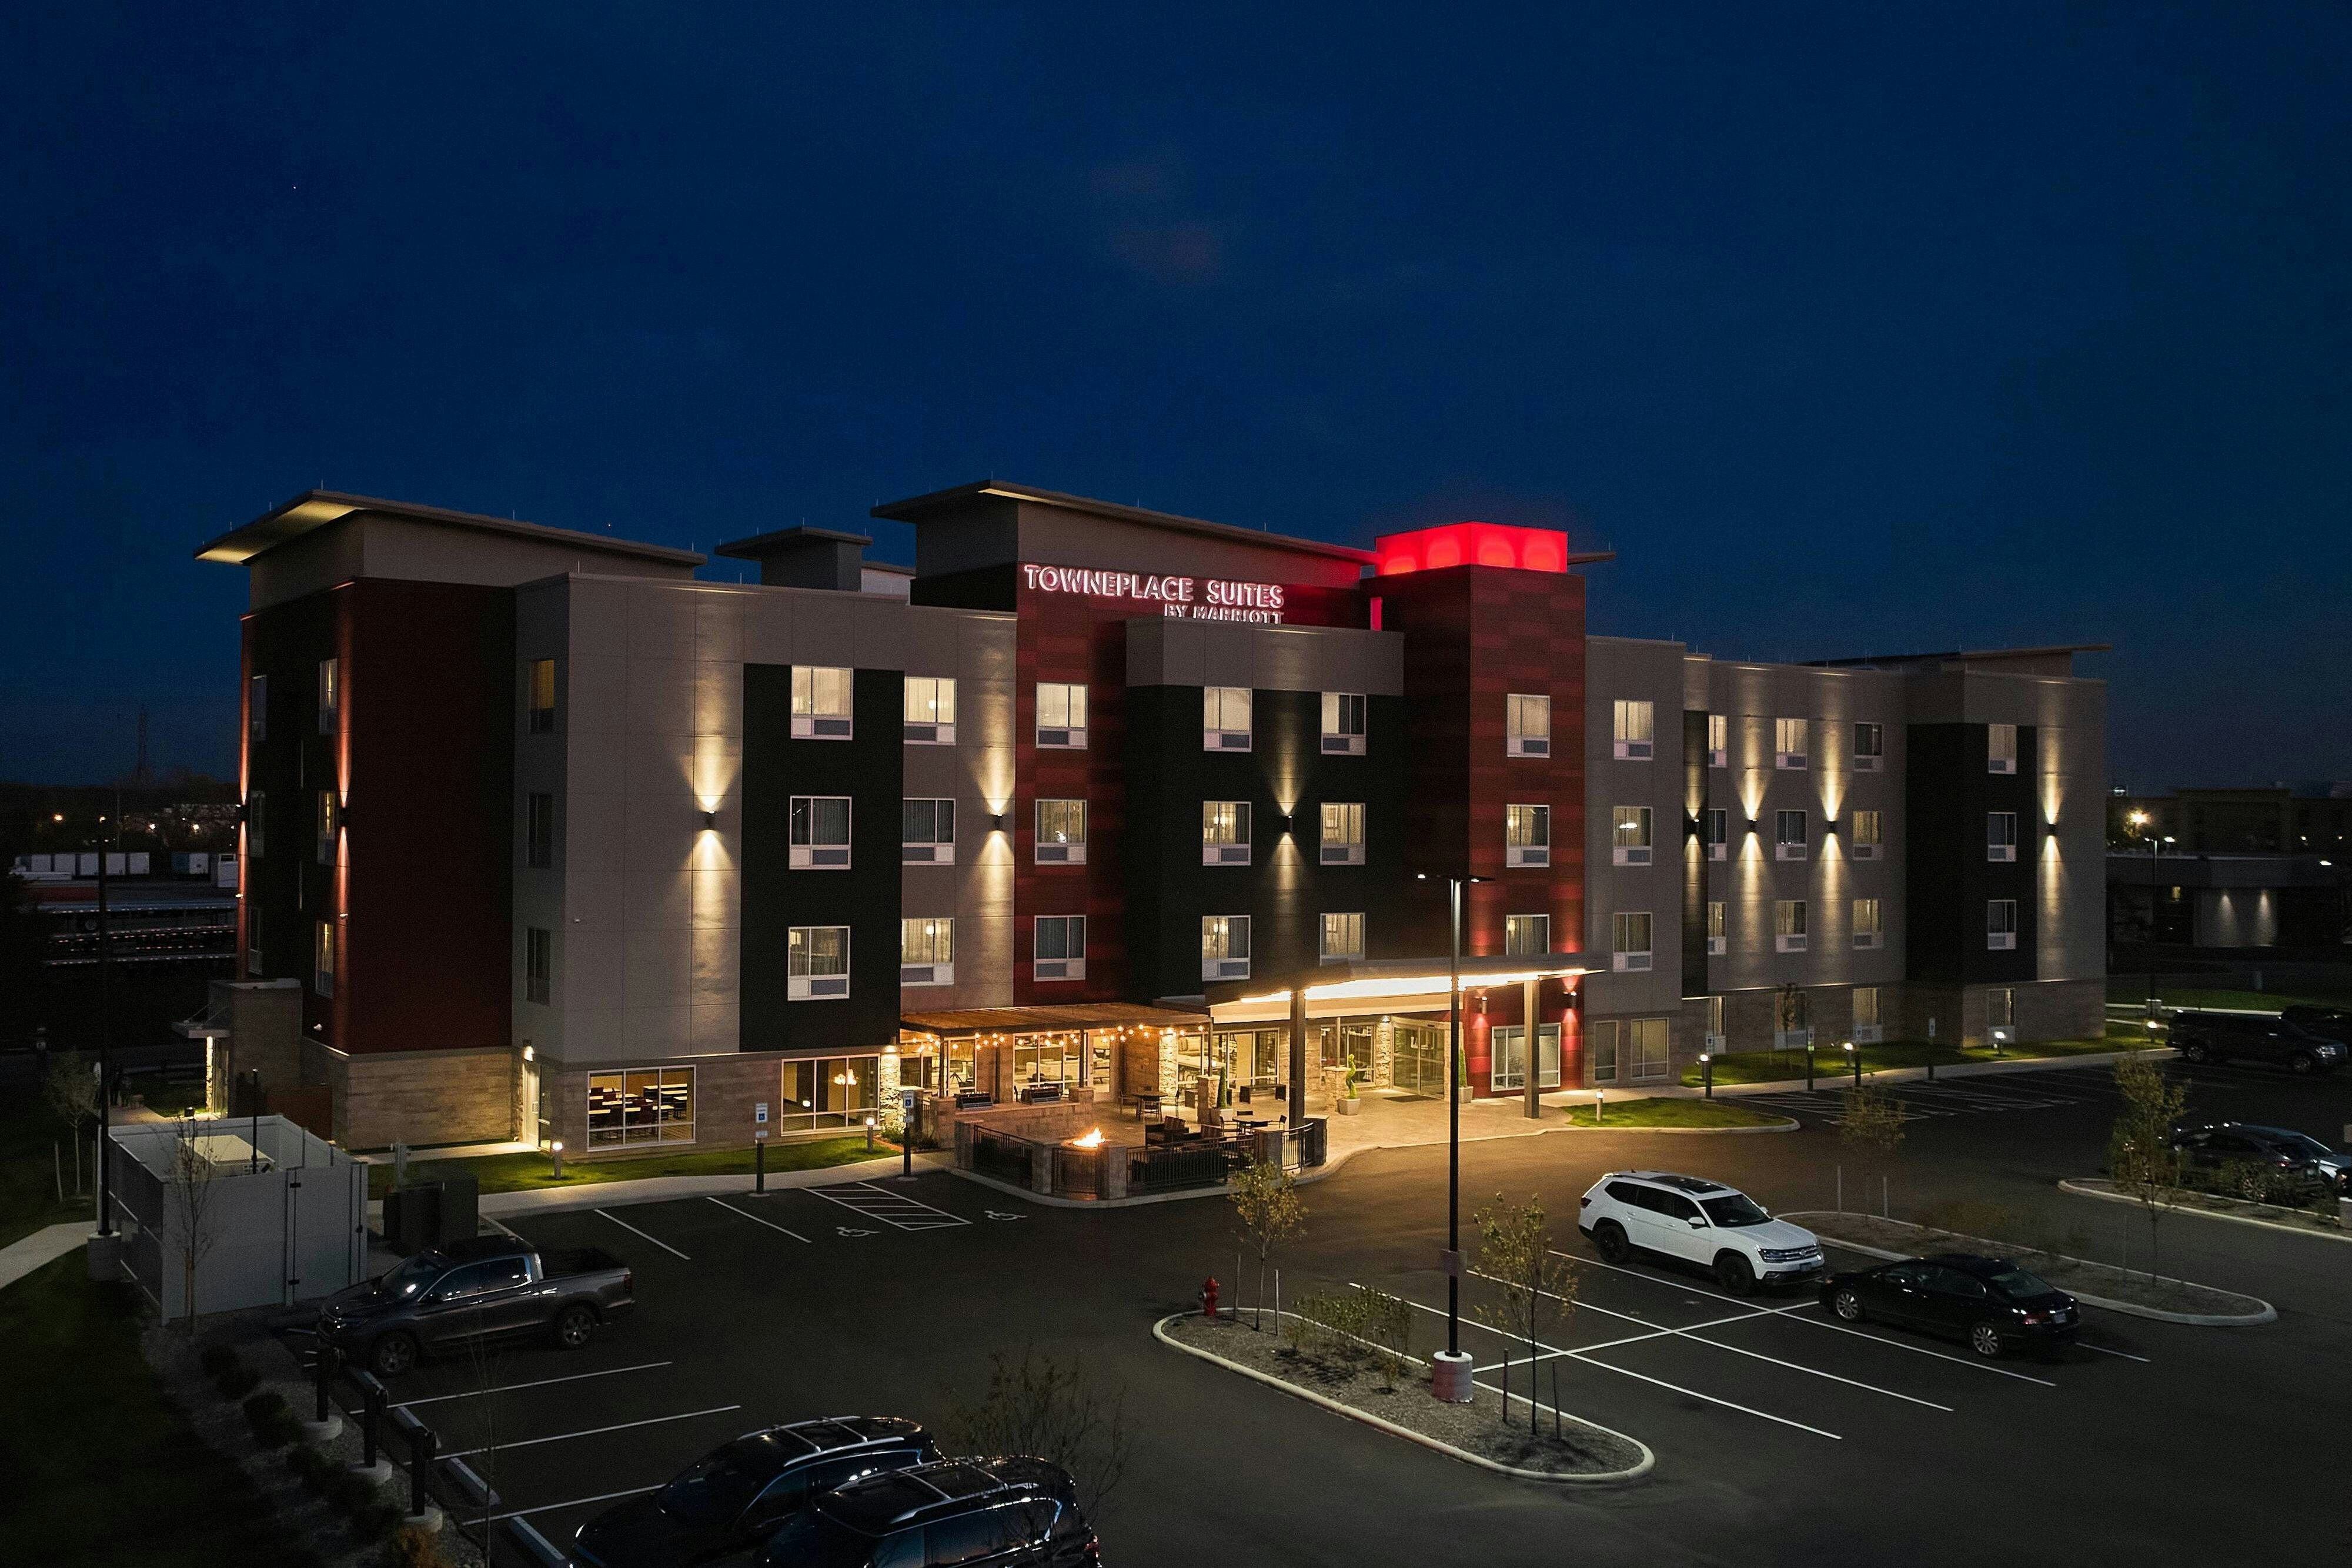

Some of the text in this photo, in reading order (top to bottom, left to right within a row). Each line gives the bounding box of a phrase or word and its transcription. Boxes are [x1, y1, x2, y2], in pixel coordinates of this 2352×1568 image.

[1024, 564, 1284, 609] TOWNEPLACE SUITES
[1164, 603, 1284, 624] BY MARRIOTT
